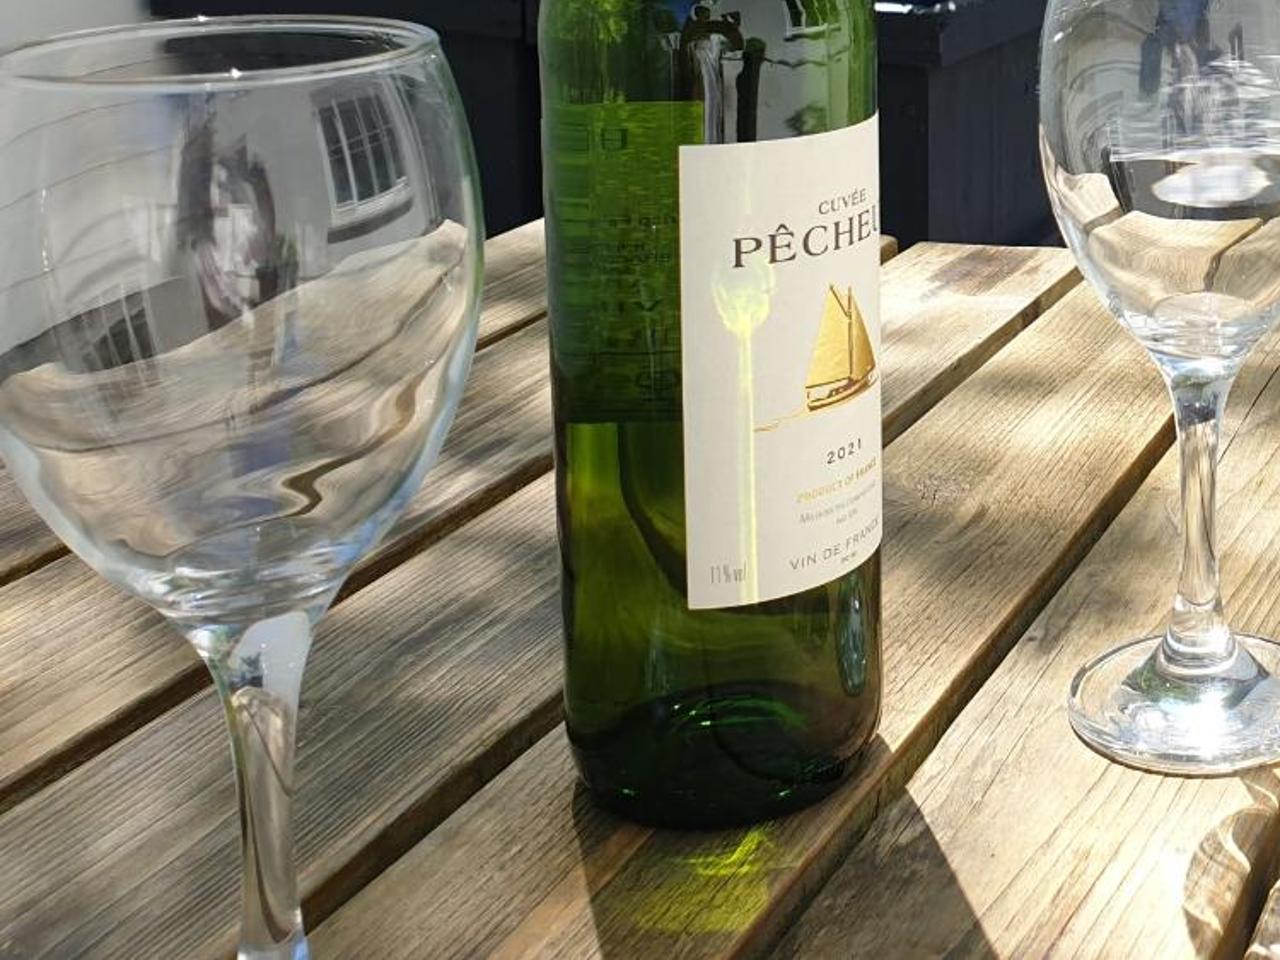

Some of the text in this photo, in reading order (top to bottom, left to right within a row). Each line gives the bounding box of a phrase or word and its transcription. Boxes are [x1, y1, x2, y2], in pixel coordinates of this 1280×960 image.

[818, 188, 867, 215] CUVÉE
[826, 438, 862, 465] 2021
[789, 552, 817, 570] VIN
[822, 543, 841, 560] DE
